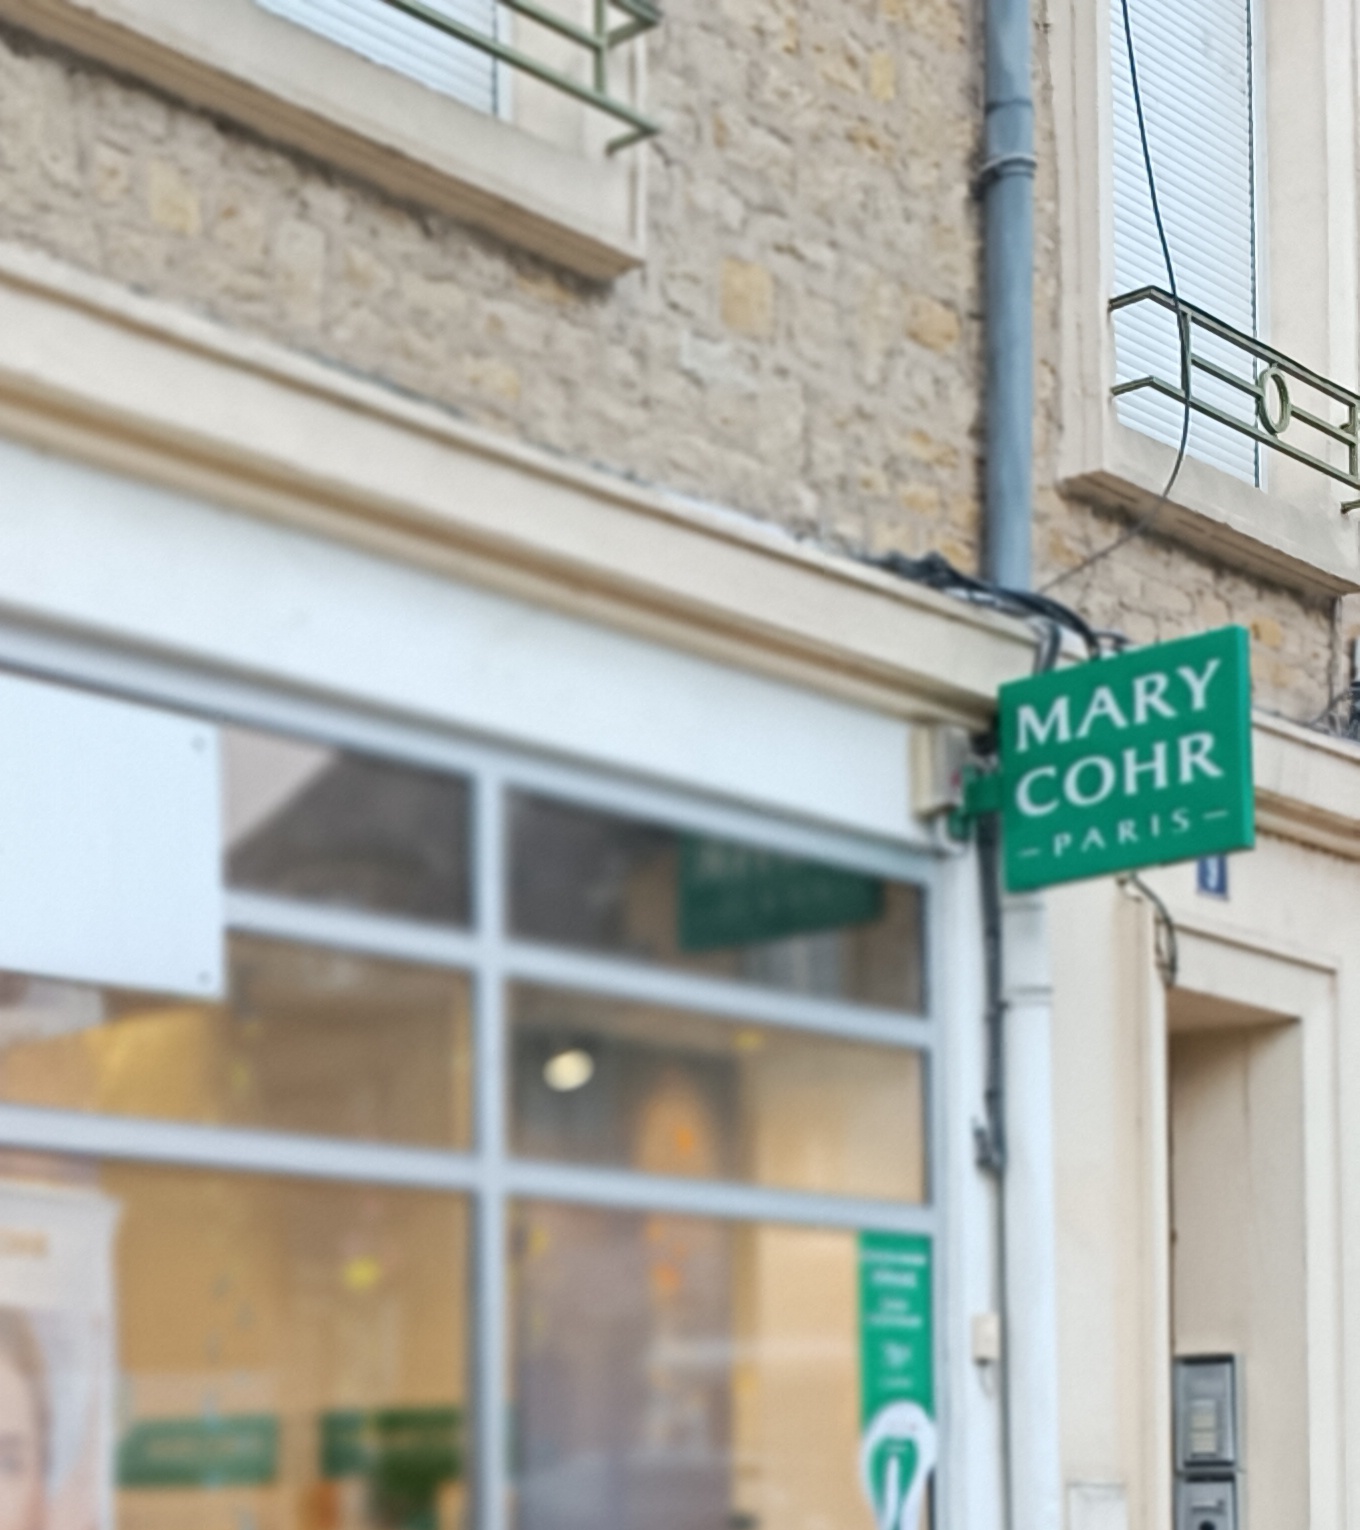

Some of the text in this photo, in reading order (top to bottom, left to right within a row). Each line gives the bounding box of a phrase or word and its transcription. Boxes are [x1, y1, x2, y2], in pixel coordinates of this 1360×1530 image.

[1016, 657, 1221, 754] MARY
[1014, 731, 1224, 819] COHR
[1053, 807, 1190, 858] PARIS
